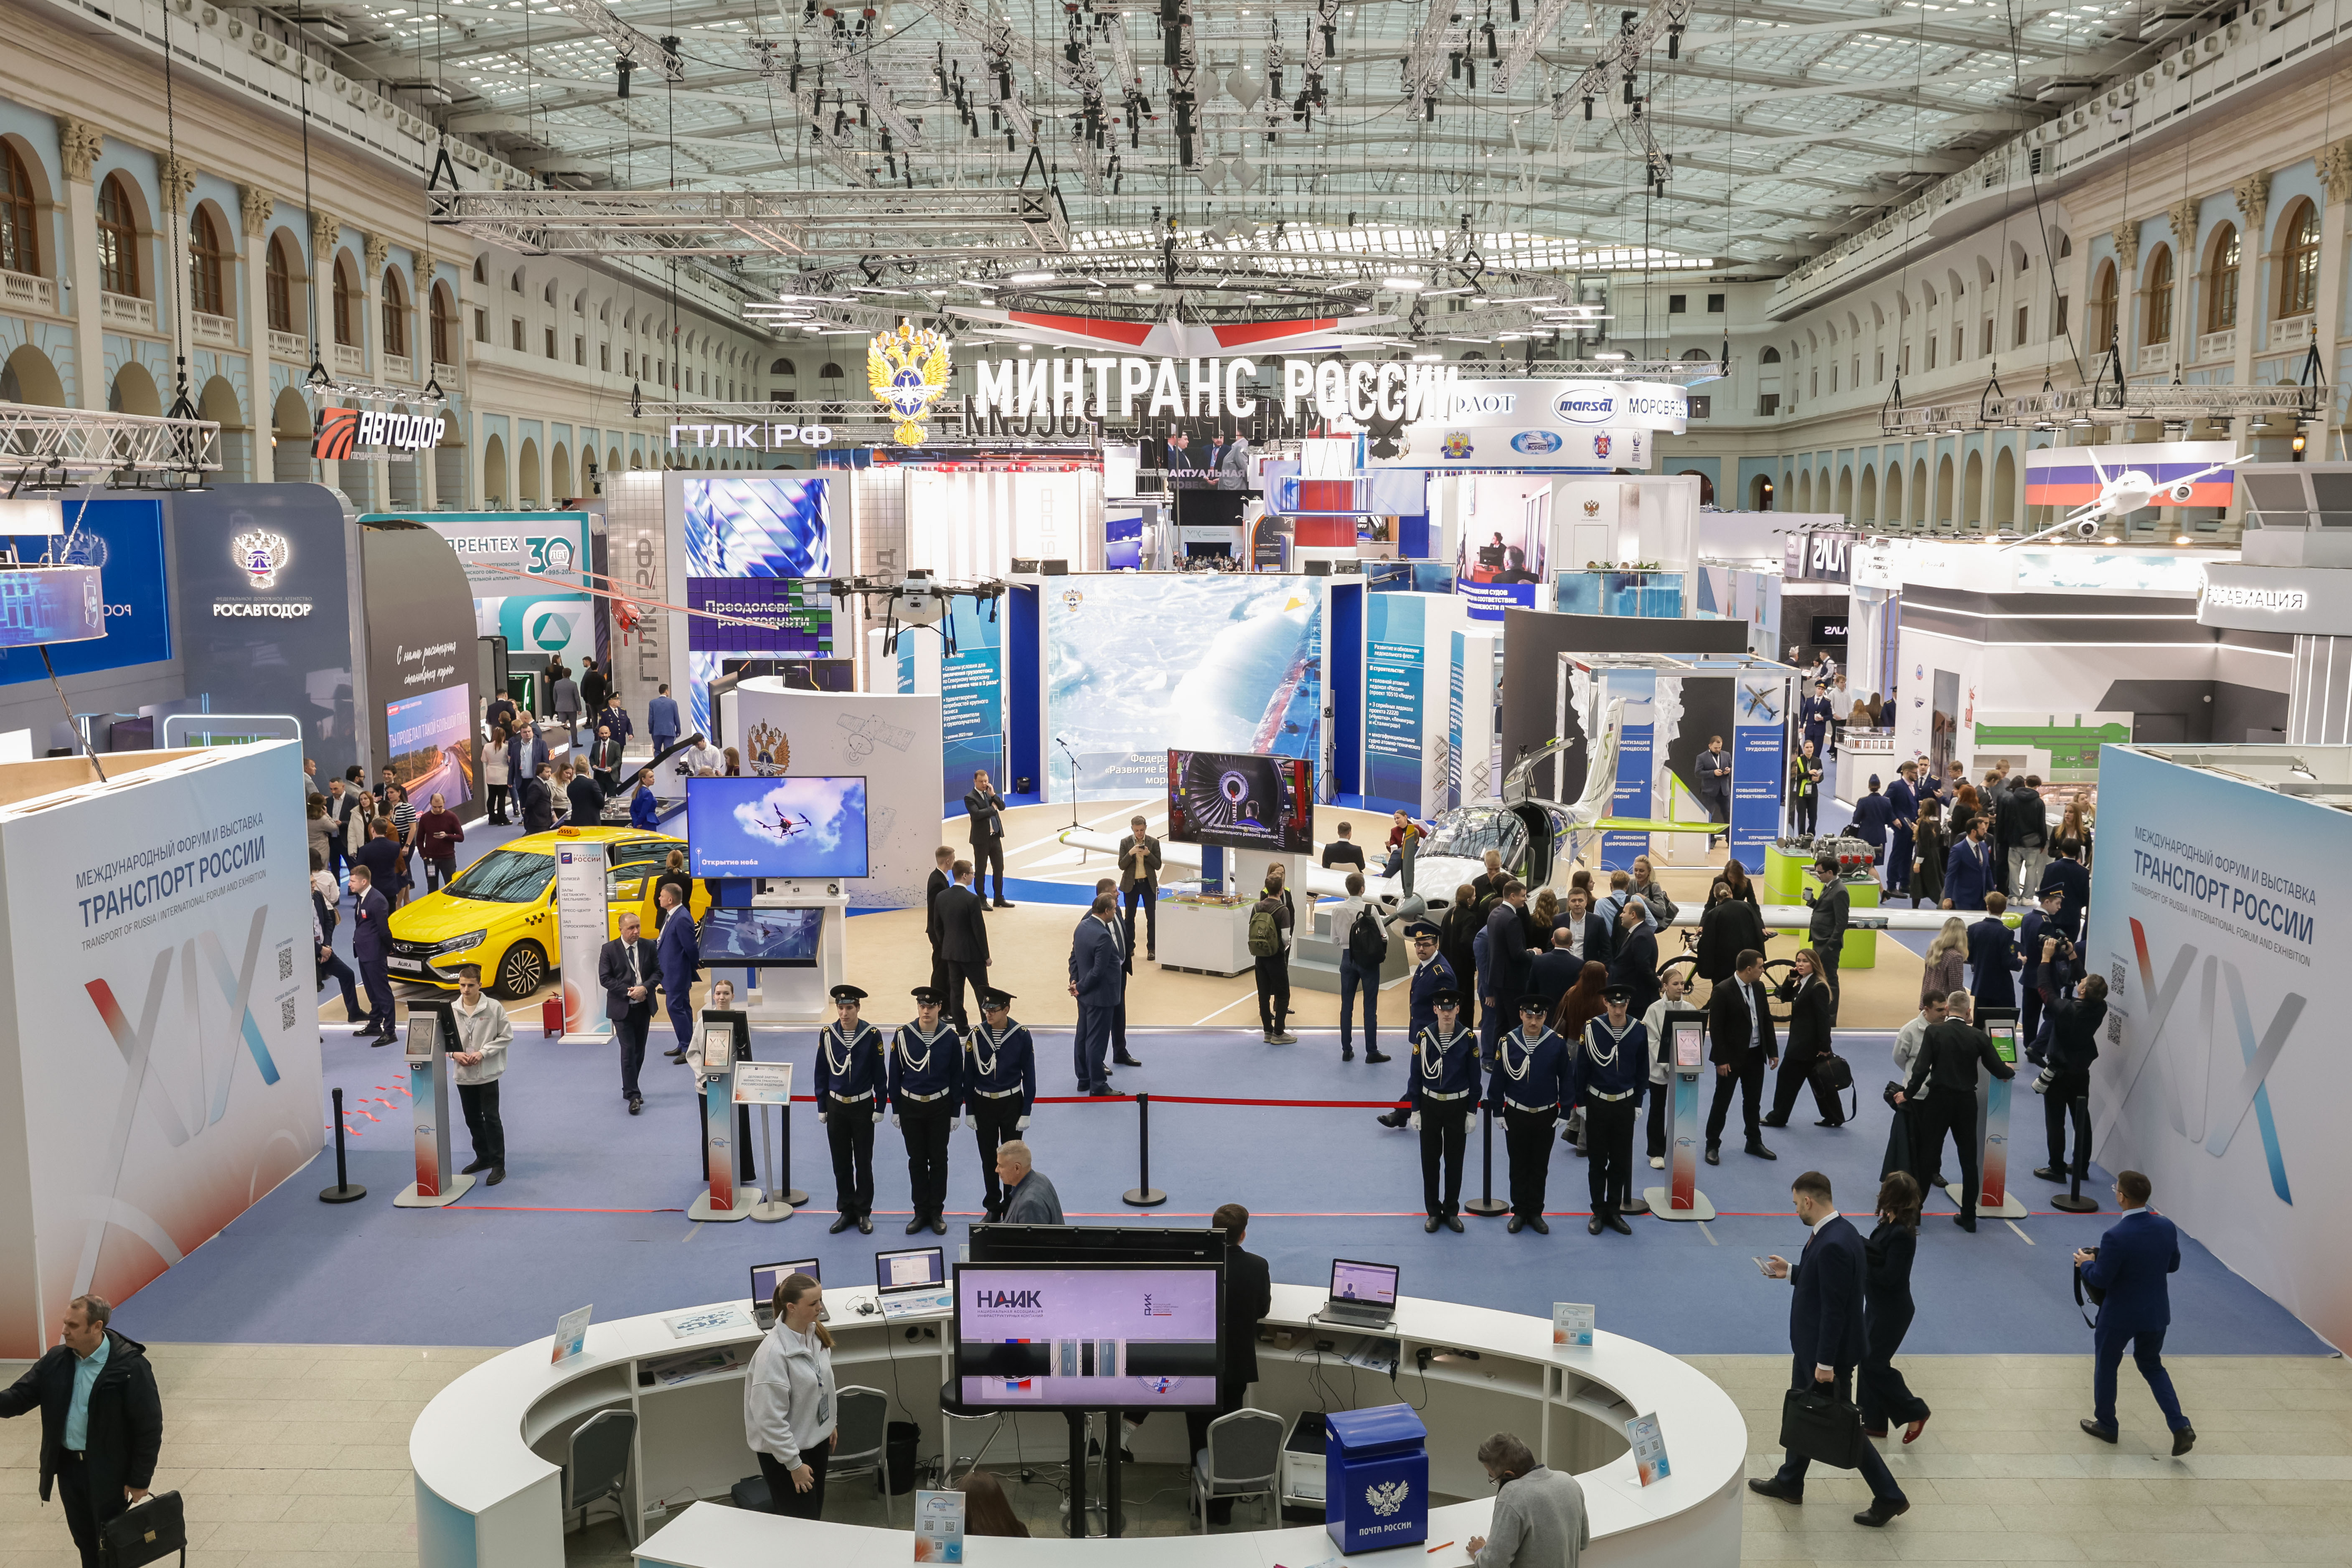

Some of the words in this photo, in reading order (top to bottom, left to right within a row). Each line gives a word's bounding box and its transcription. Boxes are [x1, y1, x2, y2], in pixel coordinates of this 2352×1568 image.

[977, 358, 1256, 417] МИНТРАНС
[1285, 359, 1458, 421] РОССИИ
[358, 411, 445, 451] АВТОДОР
[670, 424, 759, 448] ГТЛК
[774, 424, 832, 448] РФ
[525, 536, 574, 574] 30
[551, 550, 567, 559] ЛЕТ
[213, 604, 312, 619] РОСАВТОДОР
[397, 645, 402, 665] С
[404, 649, 422, 662] нами
[422, 641, 456, 666] расстояния
[404, 666, 436, 686] становятся
[437, 665, 455, 683] короче
[945, 694, 978, 703] Удовлетворение
[943, 712, 979, 722] (грузоотправители
[947, 717, 980, 728] грузополучатели)
[1372, 720, 1400, 729] «Сталинград»)
[1392, 717, 1415, 725] «Ленинград»
[389, 733, 397, 748] ТЫ
[397, 725, 422, 746] ПРОДЕЛАЛ
[422, 719, 436, 737] ТАКОЙ
[437, 713, 456, 733] БОЛЬШОЙ
[457, 712, 467, 726] ПУТЬ
[1372, 733, 1415, 743] многофункциональное
[1381, 740, 1421, 750] атомно-технического
[1368, 744, 1397, 752] обслуживания
[1131, 753, 1168, 764] Федера
[1105, 765, 1157, 775] «Развитие
[76, 839, 175, 889] МЕЖДУНАРОДНЫЙ
[178, 831, 210, 853] ФОРУМ
[212, 828, 218, 841] И
[221, 813, 264, 839] ВЫСТАВКА
[701, 859, 739, 867] Открытие
[2134, 826, 2213, 867] МЕЖДУНАРОДНЫЙ
[2215, 856, 2250, 880] ФОРУМ
[2252, 868, 2259, 883] И
[2261, 872, 2316, 906] ВЫСТАВКА
[79, 861, 195, 927] ТРАНСПОРТ
[200, 836, 265, 882] РОССИИ
[2134, 849, 2229, 909] ТРАНСПОРТ
[2233, 888, 2314, 945] РОССИИ
[82, 927, 122, 951] TRANSPORT
[124, 925, 132, 934] OF
[134, 914, 157, 931] RUSSIA
[160, 895, 206, 920] INTERNATIONAL
[206, 886, 226, 902] FORUM
[226, 880, 238, 894] AND
[239, 869, 266, 889] EXHIBITION
[2131, 882, 2161, 902] TRANSPORT
[2162, 895, 2168, 905] OF
[2169, 898, 2188, 915] RUSSIA
[2192, 908, 2235, 935] INTERNATIONAL
[2236, 927, 2258, 945] FORUM
[2259, 937, 2273, 950] AND
[2273, 943, 2311, 967] EXHIBITION
[1359, 1524, 1382, 1536] ПОЧТА
[1384, 1521, 1412, 1533] РОССИИ
